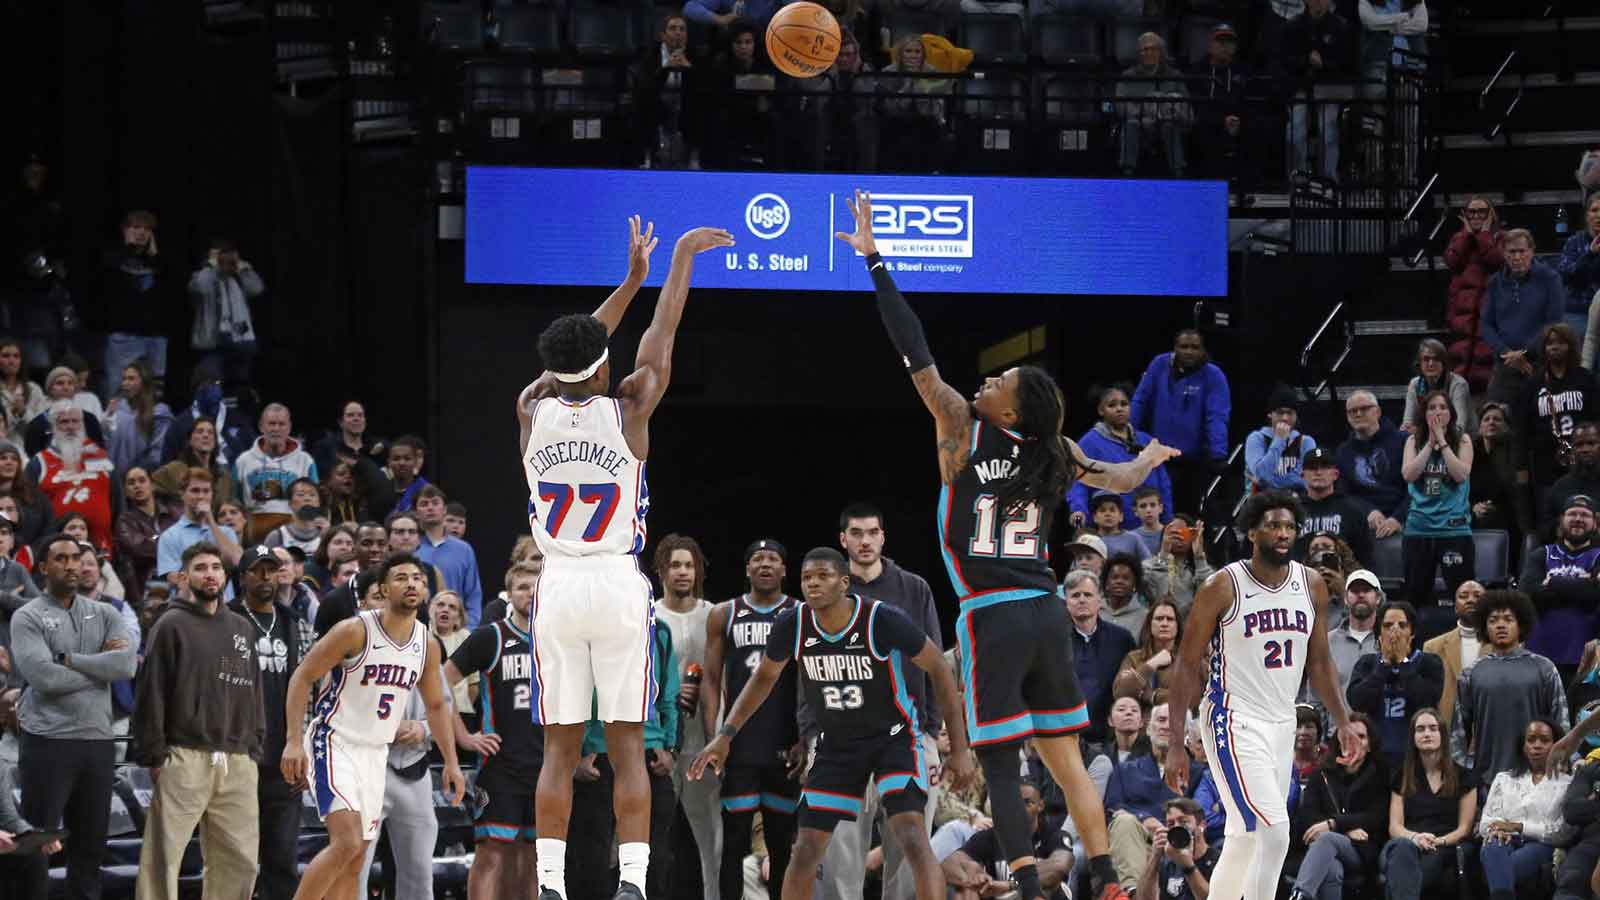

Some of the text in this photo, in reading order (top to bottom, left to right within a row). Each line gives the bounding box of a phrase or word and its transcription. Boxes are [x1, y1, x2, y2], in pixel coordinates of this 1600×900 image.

[752, 205, 784, 229] USS
[871, 203, 964, 235] BRS
[910, 244, 935, 253] RIVER
[938, 245, 964, 253] STEEL
[726, 253, 808, 271] U. S. Steel
[923, 263, 964, 273] company
[529, 441, 629, 477] EDGECOMBE
[537, 481, 620, 542] 77
[968, 494, 1042, 560] 12
[732, 622, 773, 648] MEMP
[1243, 608, 1308, 638] PHILA
[1264, 639, 1293, 669] 21
[802, 655, 873, 681] MEMPHIS
[377, 693, 395, 720] 5
[823, 685, 864, 711] 23
[1383, 697, 1405, 717] 12
